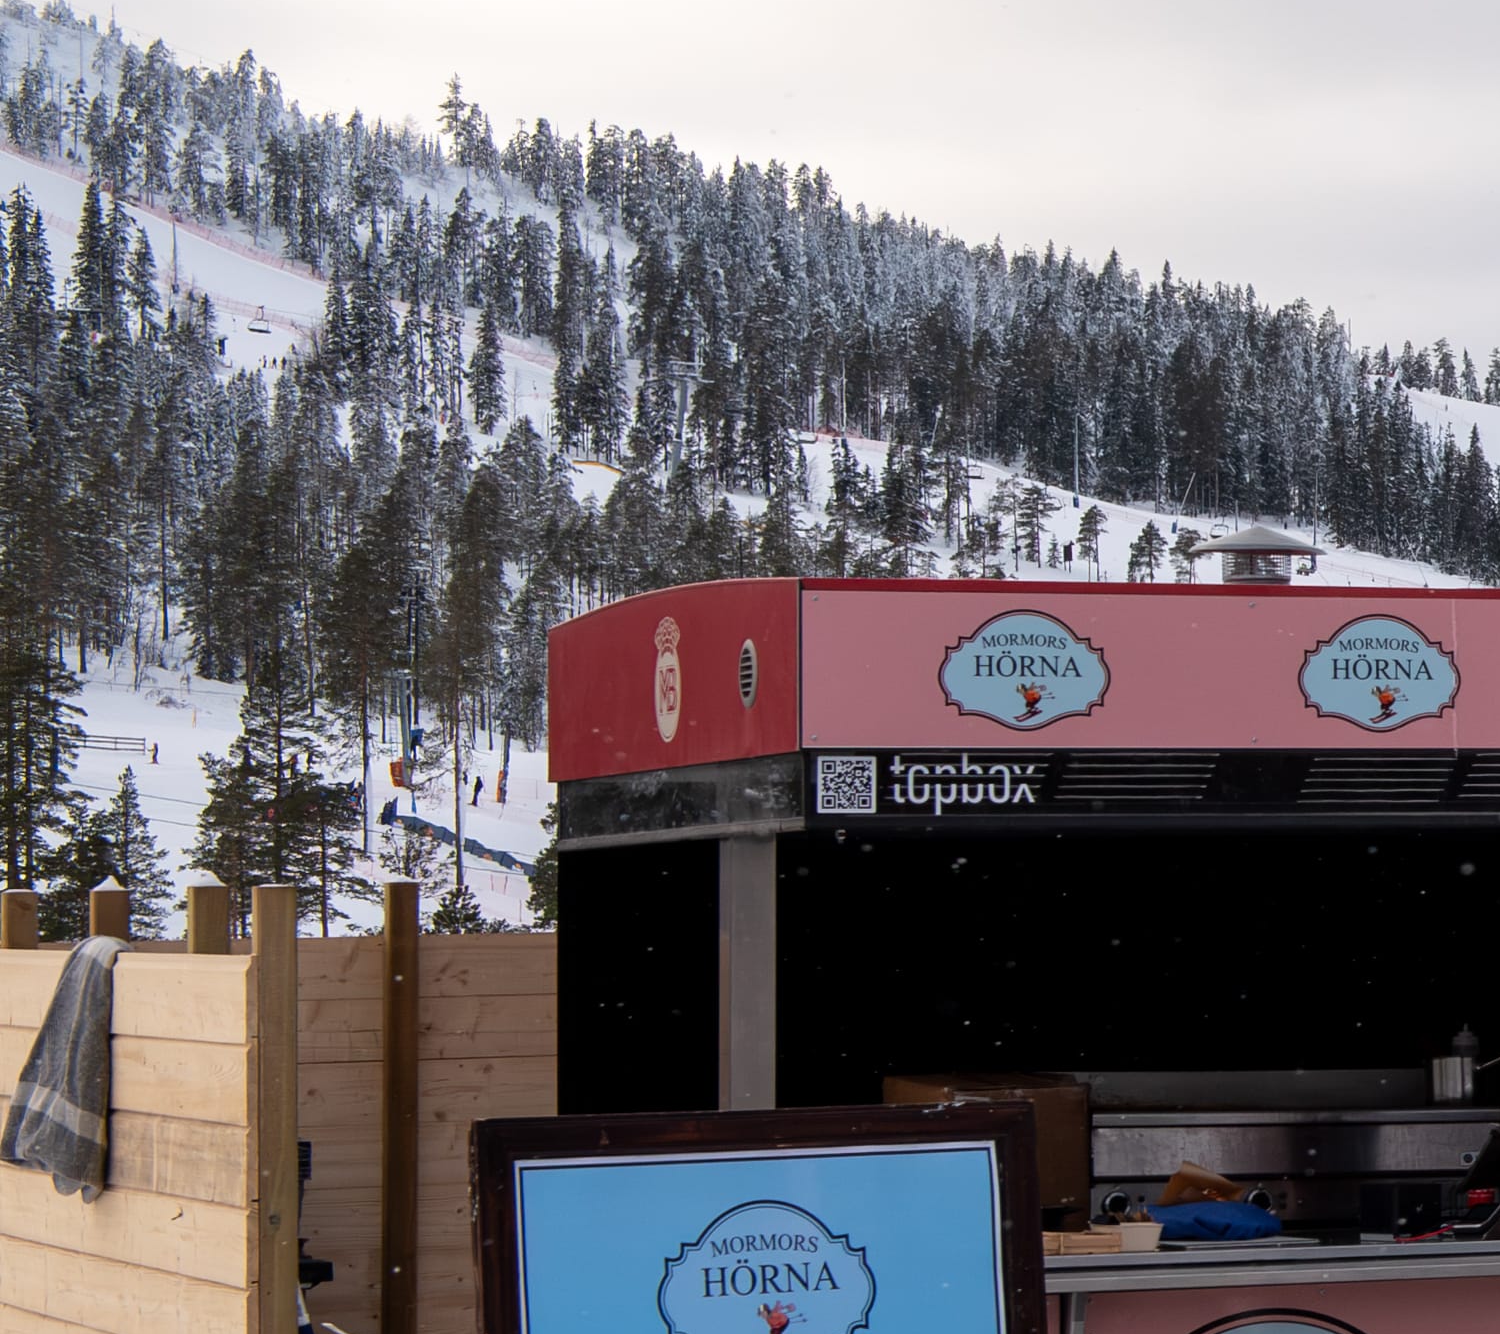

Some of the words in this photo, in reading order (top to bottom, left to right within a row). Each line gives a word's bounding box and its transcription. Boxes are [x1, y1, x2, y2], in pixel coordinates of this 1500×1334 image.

[981, 633, 1068, 650] MORMORS
[1339, 637, 1419, 653] MORMORS
[973, 650, 1083, 678] HÖRNA
[1331, 654, 1434, 680] HÖRNA
[890, 753, 1036, 815] topbox
[710, 1233, 819, 1258] MORMORS
[701, 1258, 840, 1298] HÖRNA
